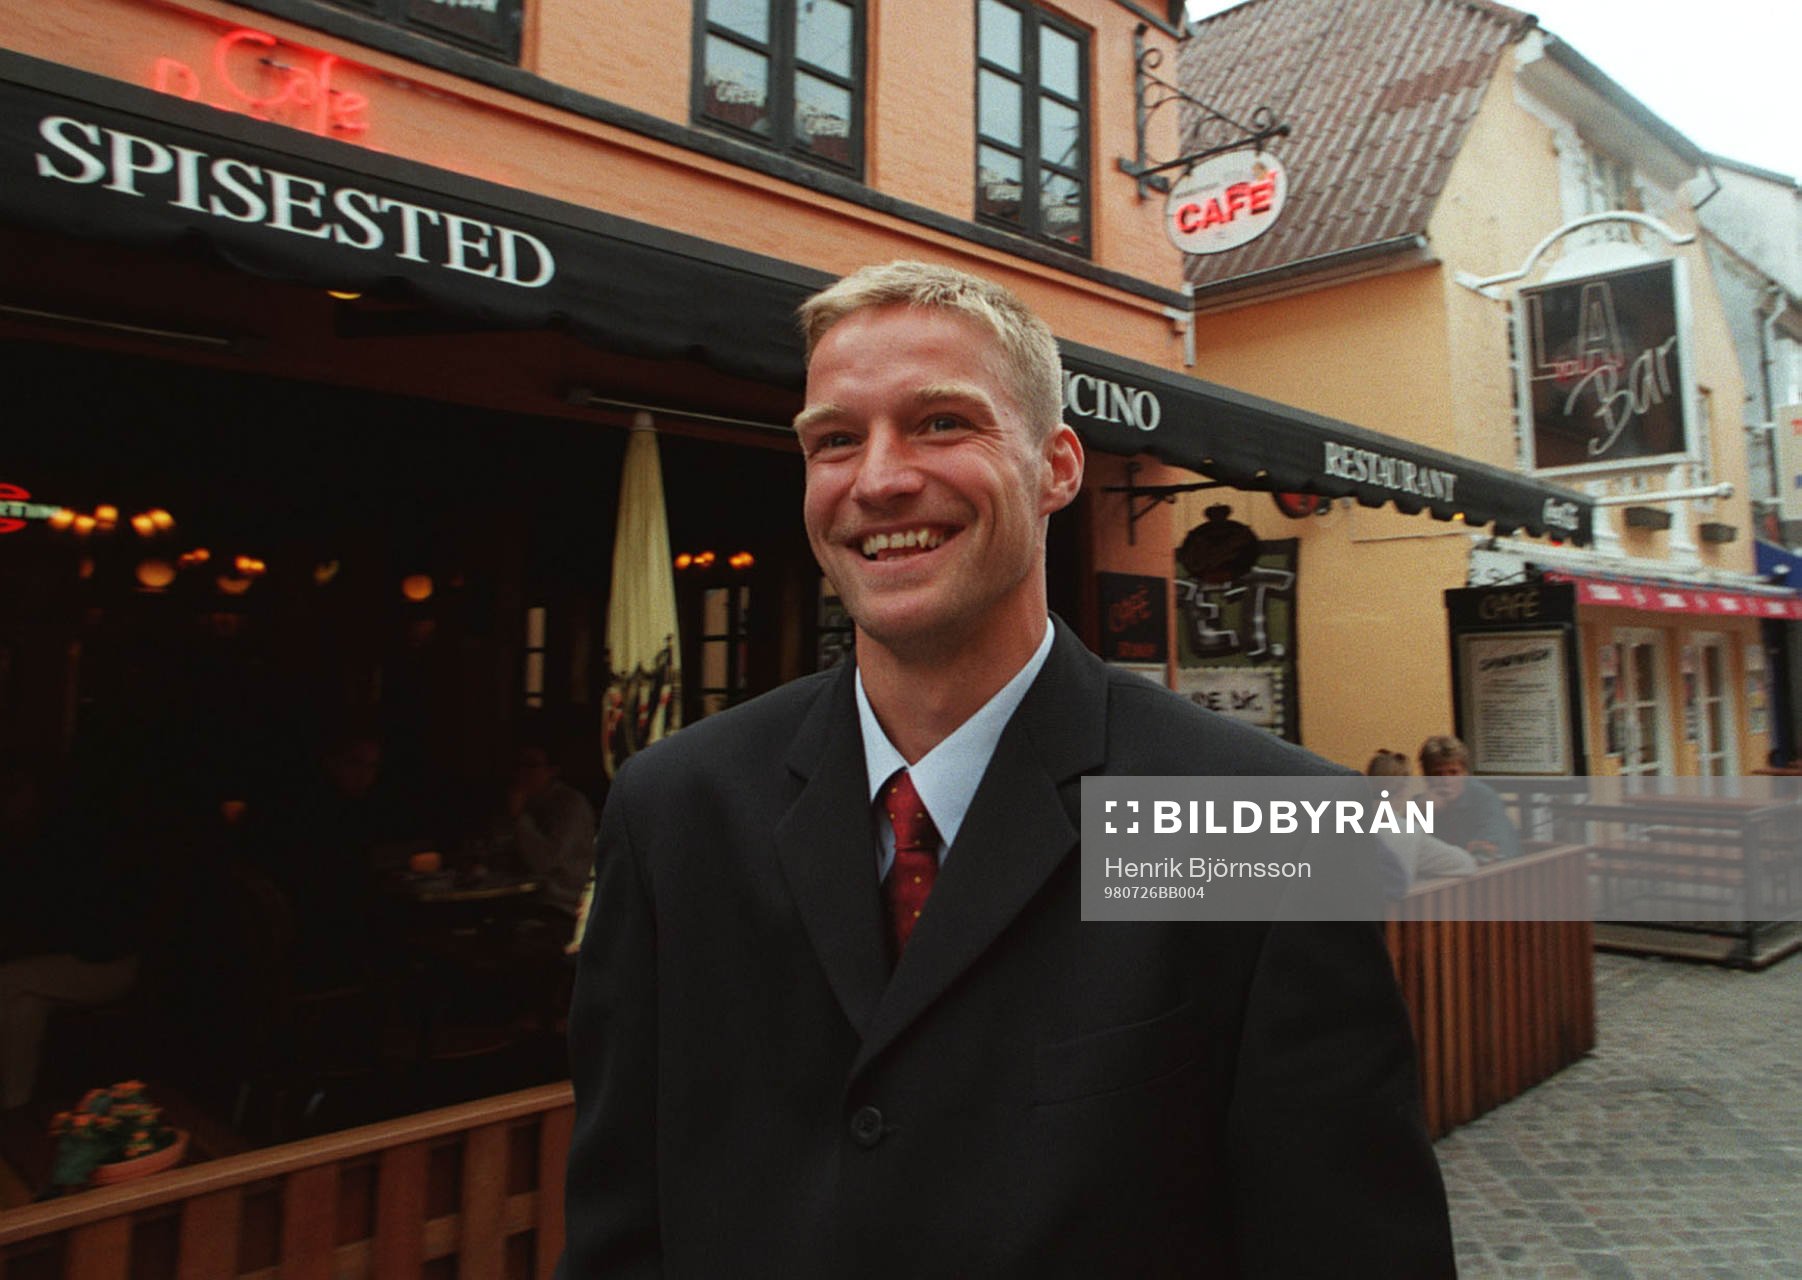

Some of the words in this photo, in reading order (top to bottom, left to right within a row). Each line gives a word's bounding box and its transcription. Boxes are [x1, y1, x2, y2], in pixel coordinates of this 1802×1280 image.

[35, 115, 556, 289] SPISESTED
[1563, 335, 1678, 455] Bar
[1324, 441, 1458, 502] RESTAURANT
